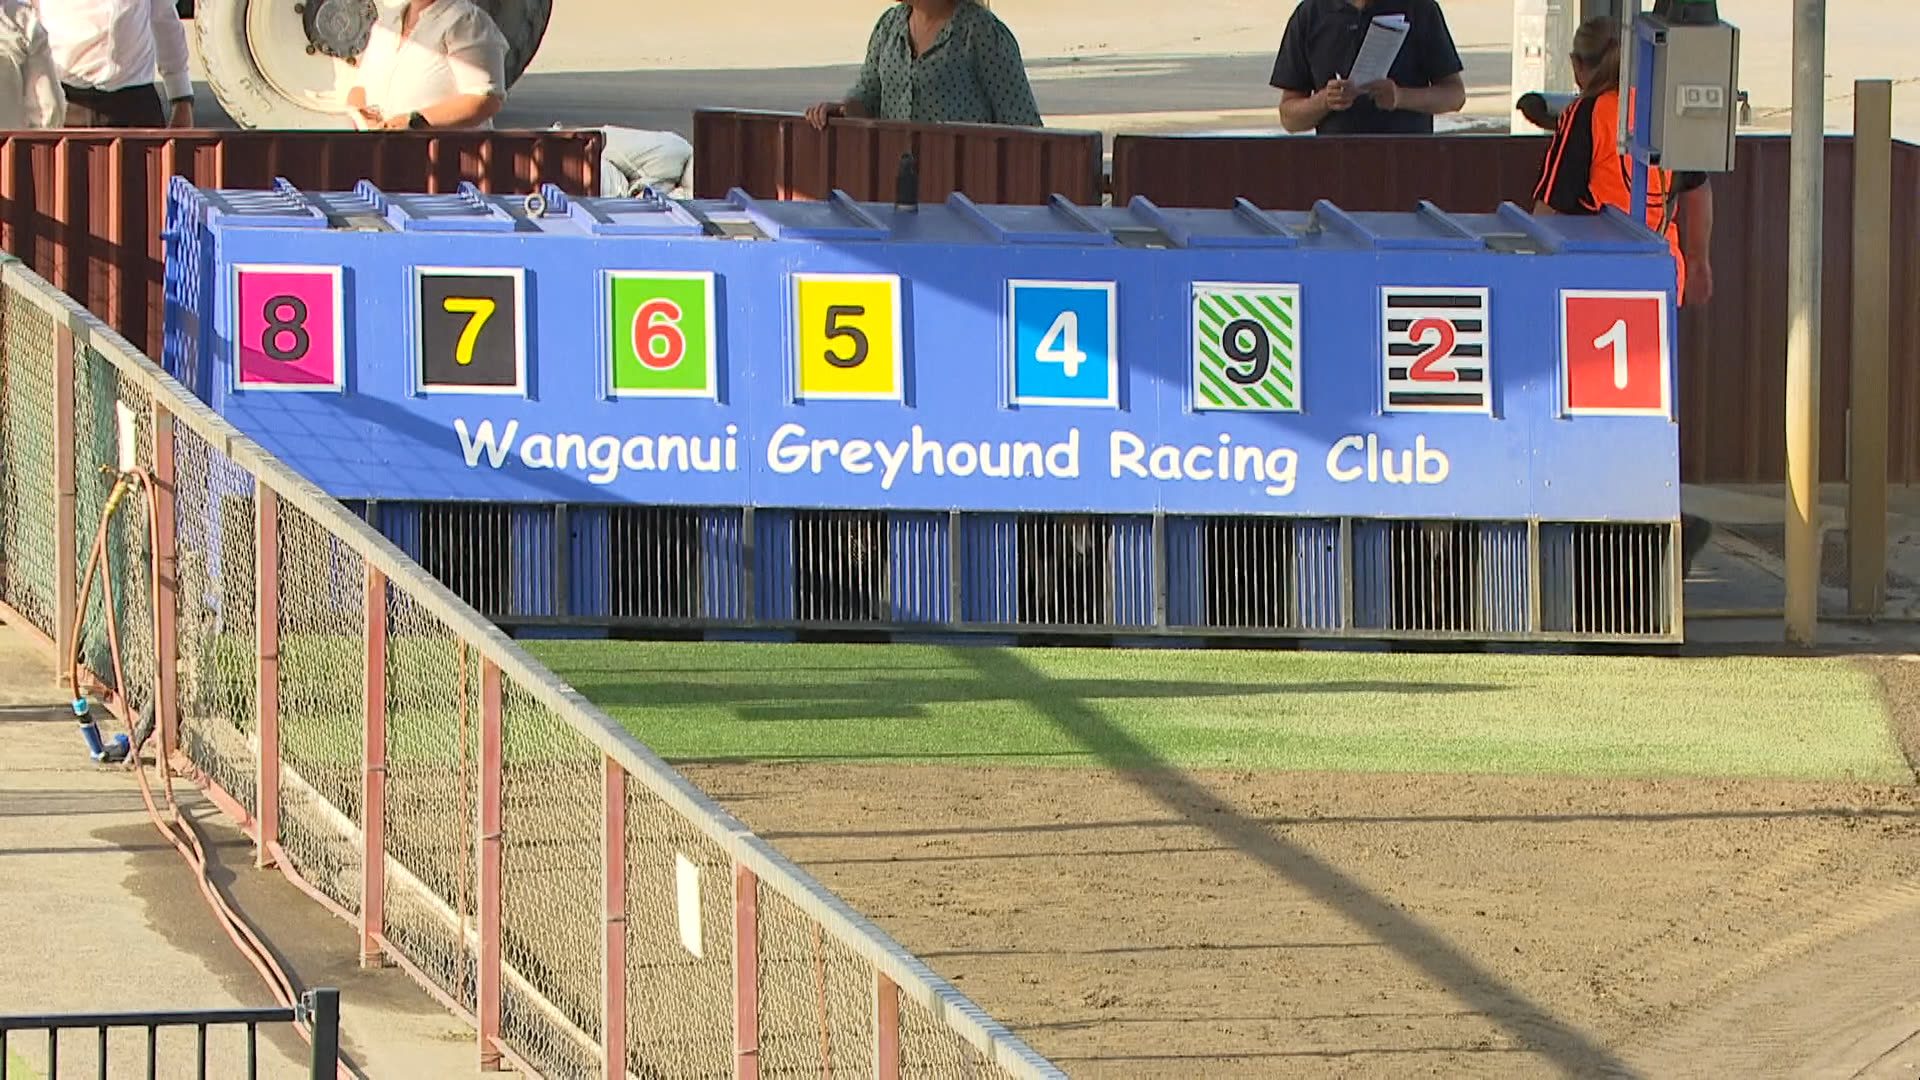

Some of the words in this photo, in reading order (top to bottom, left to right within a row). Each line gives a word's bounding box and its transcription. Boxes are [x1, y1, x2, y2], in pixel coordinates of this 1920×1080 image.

[261, 295, 310, 361] 8
[444, 298, 496, 365] 7
[632, 299, 686, 369] 6
[824, 306, 869, 368] 5
[1035, 311, 1087, 377] 4
[1222, 319, 1271, 385] 9
[1407, 318, 1459, 383] 2
[1593, 319, 1629, 390] 1
[454, 418, 738, 484] Wanganui
[767, 424, 1080, 489] Greyhound
[1110, 431, 1298, 496] Racing
[1326, 433, 1451, 485] Club
